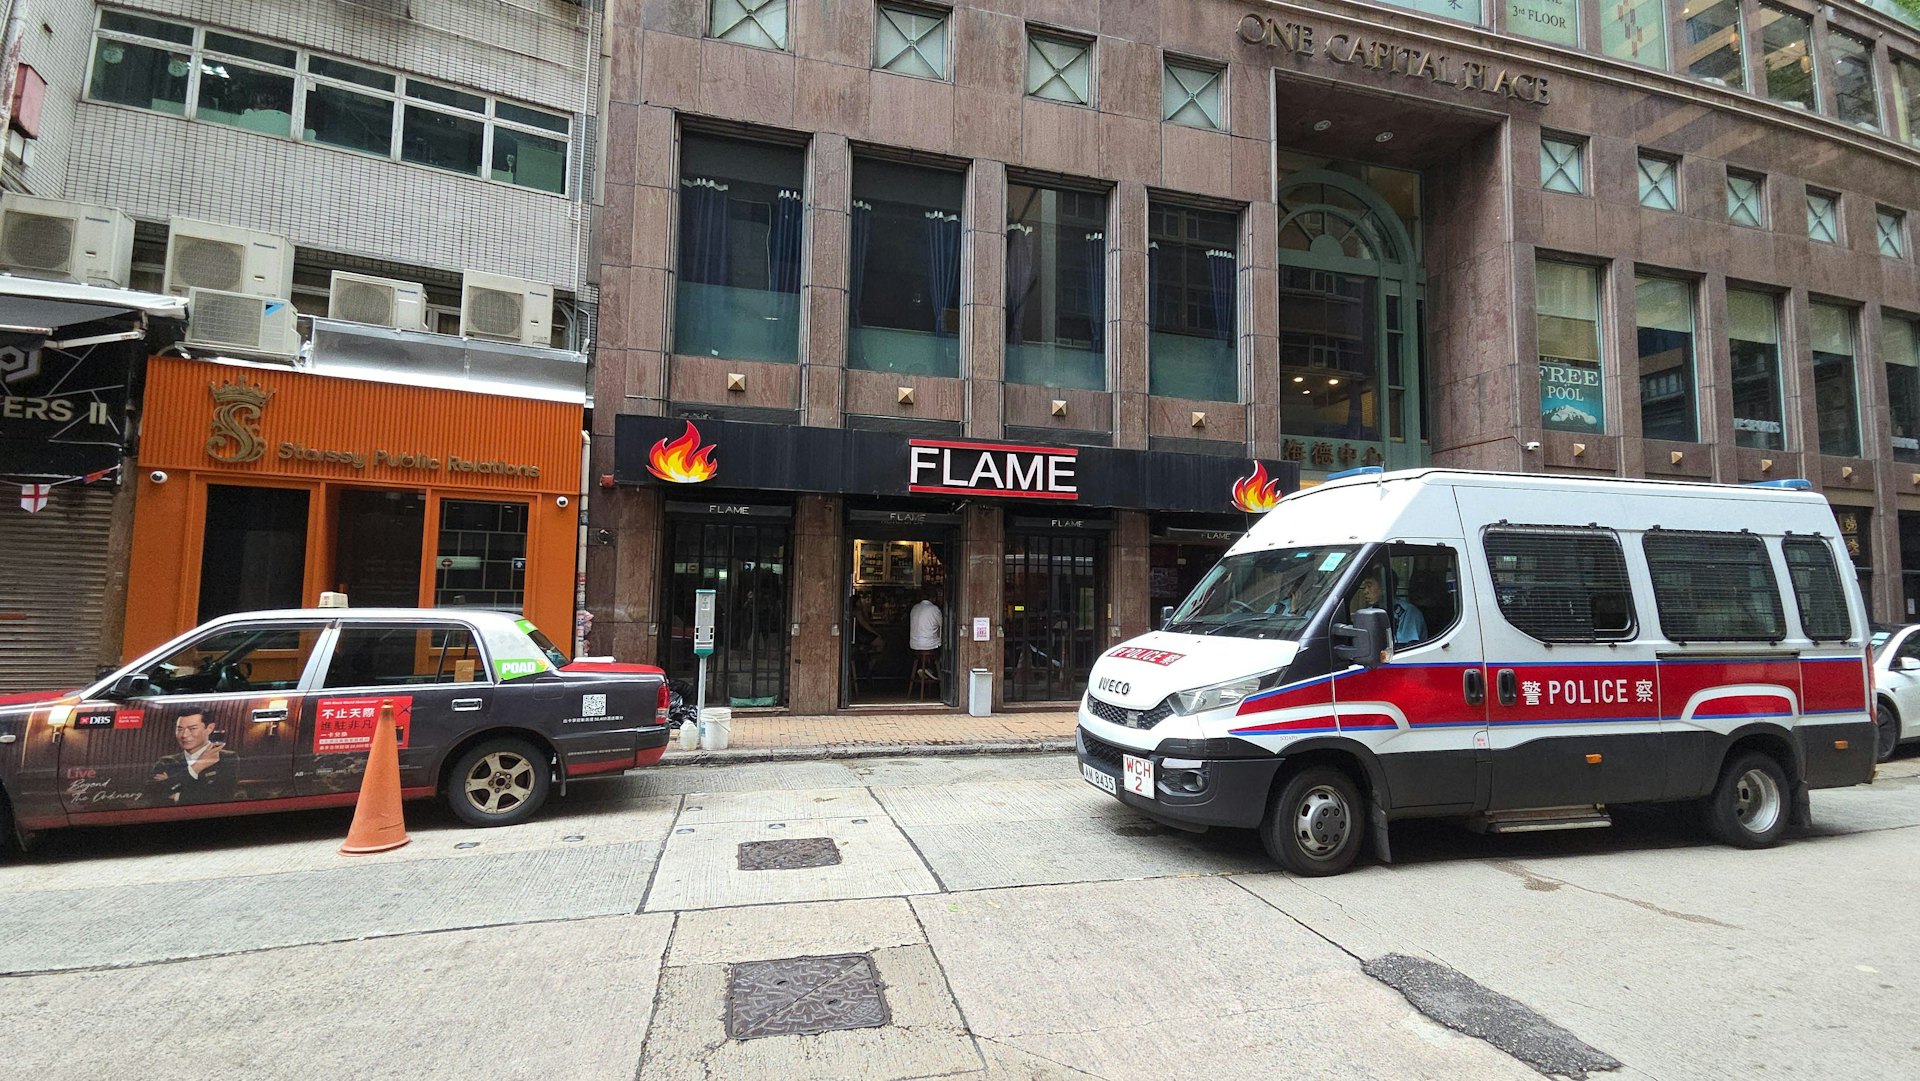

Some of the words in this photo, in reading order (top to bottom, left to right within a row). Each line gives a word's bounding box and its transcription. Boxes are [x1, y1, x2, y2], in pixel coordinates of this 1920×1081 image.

[1512, 5, 1525, 17] 3rd
[1528, 9, 1567, 29] FLOOR
[1236, 13, 1315, 57] ONE
[1324, 34, 1458, 86] CAPITAL
[1457, 60, 1550, 105] PLACE
[1539, 366, 1599, 387] FREE
[1547, 385, 1584, 401] POOL
[278, 441, 366, 468] Starssy
[374, 448, 440, 470] Public
[447, 455, 541, 478] Relations
[1283, 438, 1383, 467] 海德中心
[910, 446, 1077, 493] FLAME
[709, 505, 750, 515] FLAME
[890, 512, 927, 522] FLAME
[1051, 519, 1085, 528] FLAME
[1201, 532, 1232, 540] FLAME
[1119, 648, 1168, 662] POLICE
[502, 661, 536, 674] POAD
[1098, 676, 1131, 696] IVECO
[1522, 681, 1542, 705] 警
[1549, 679, 1629, 705] POLICE
[1635, 679, 1654, 703] 察
[89, 716, 111, 724] DBS
[67, 768, 96, 779] Live
[1126, 757, 1151, 778] WCH
[67, 778, 111, 791] Beyond
[1085, 765, 1093, 780] AM
[1095, 771, 1114, 791] 8435
[1135, 777, 1142, 792] 2
[71, 791, 88, 803] The
[92, 790, 143, 803] Ordinary
